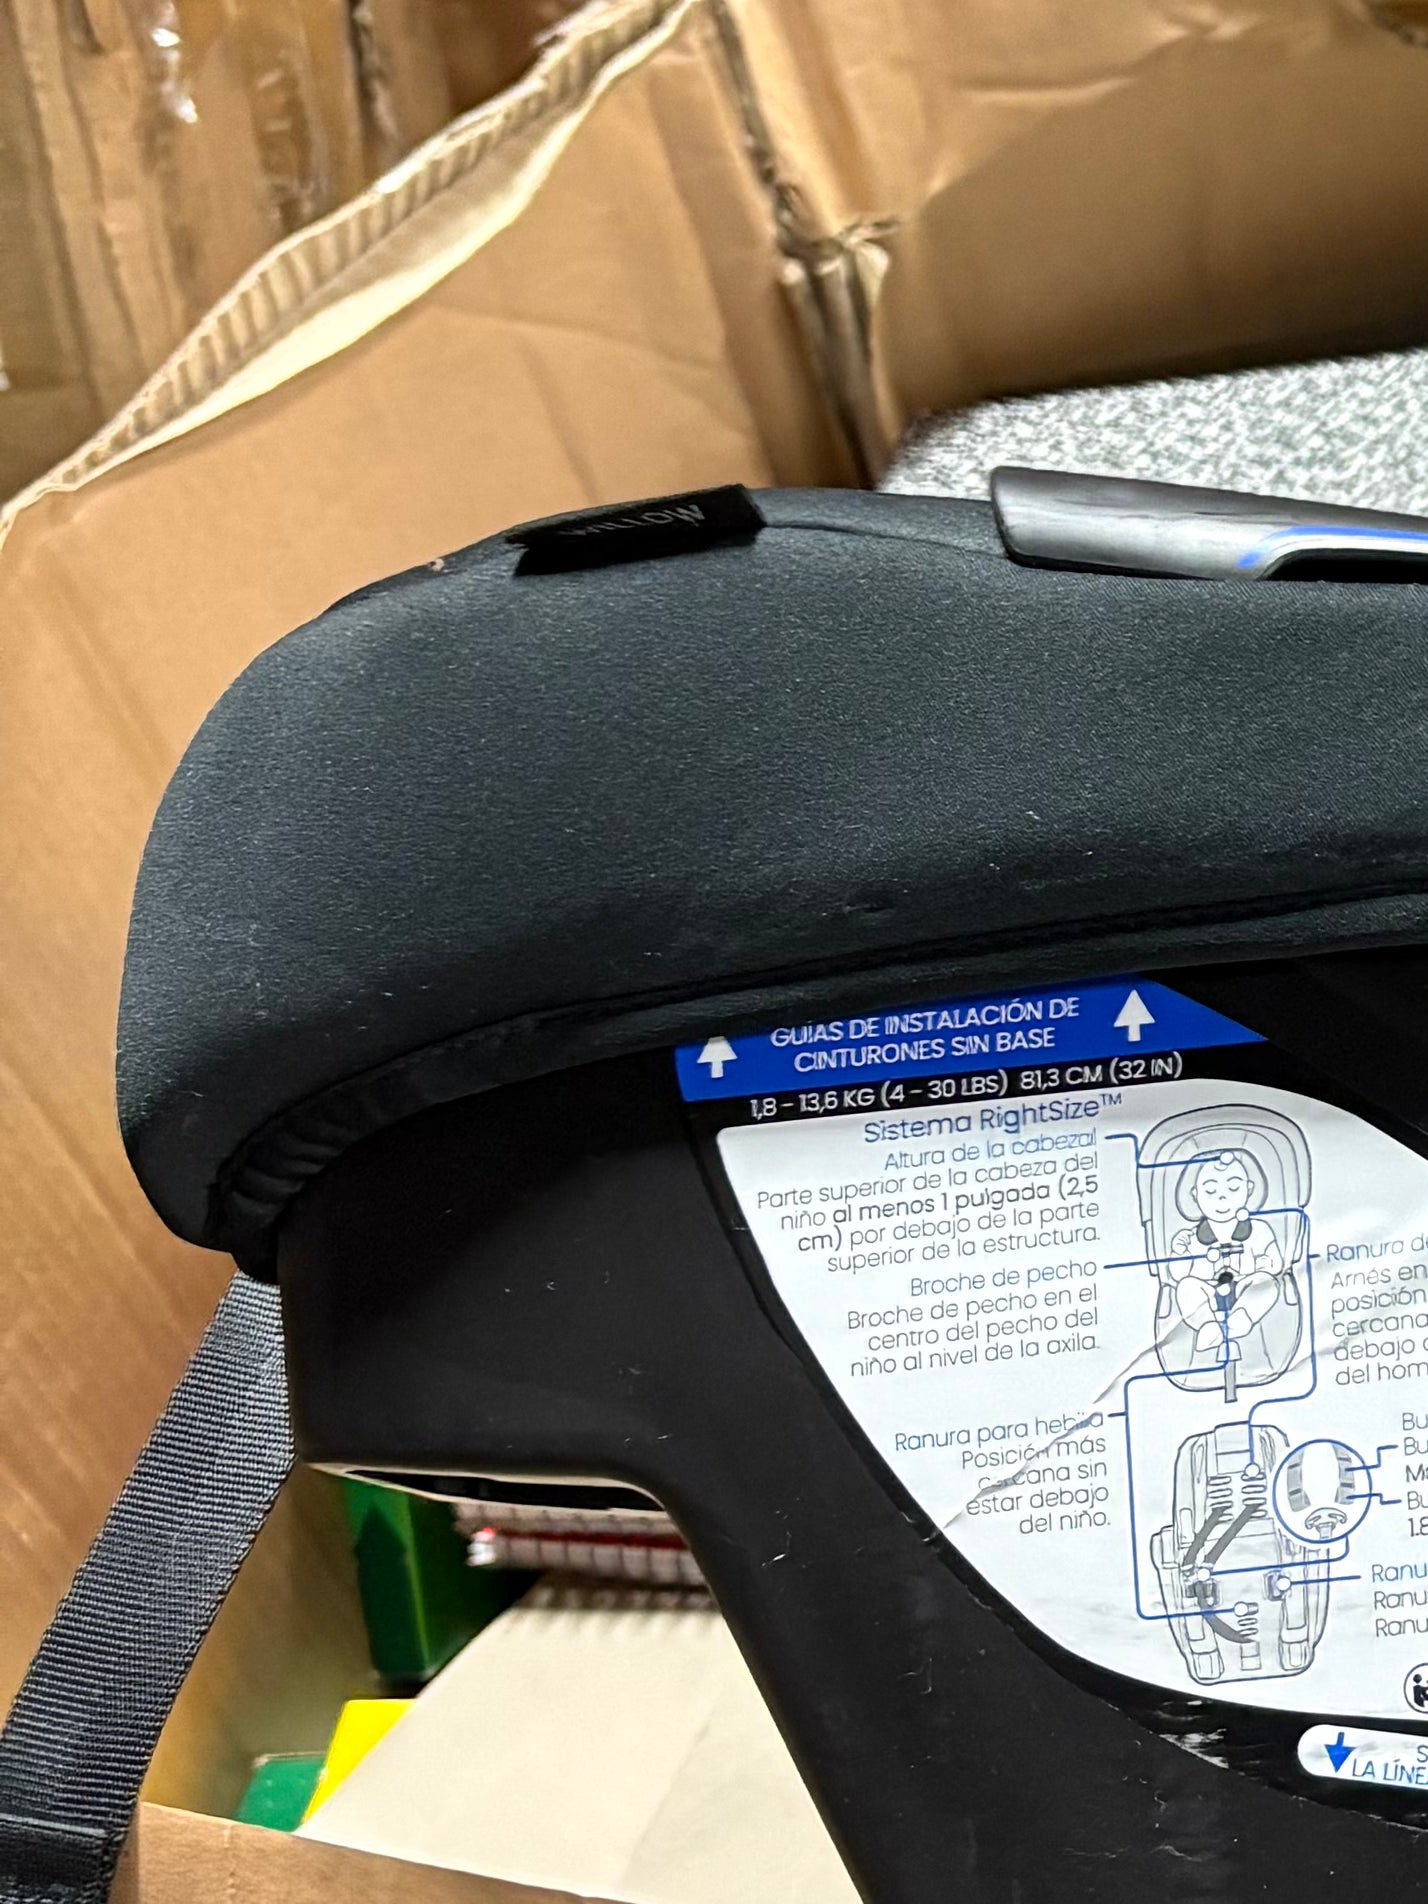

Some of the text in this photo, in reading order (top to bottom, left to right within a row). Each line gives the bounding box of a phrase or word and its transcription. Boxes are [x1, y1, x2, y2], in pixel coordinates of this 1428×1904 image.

[793, 1026, 1056, 1073] CINTURONES SIN BASE
[863, 1114, 973, 1144] Sistema
[883, 1126, 1097, 1172] Altura de la cabezal
[756, 1151, 1100, 1210] Parte superior de la cabeza del
[780, 1209, 827, 1231] niño
[832, 1196, 855, 1224] al
[858, 1197, 936, 1222] menos
[954, 1181, 1051, 1216] pulgada
[910, 1258, 1098, 1298] Broche de pecho
[1018, 1511, 1053, 1535] del
[1352, 1757, 1376, 1777] LA
